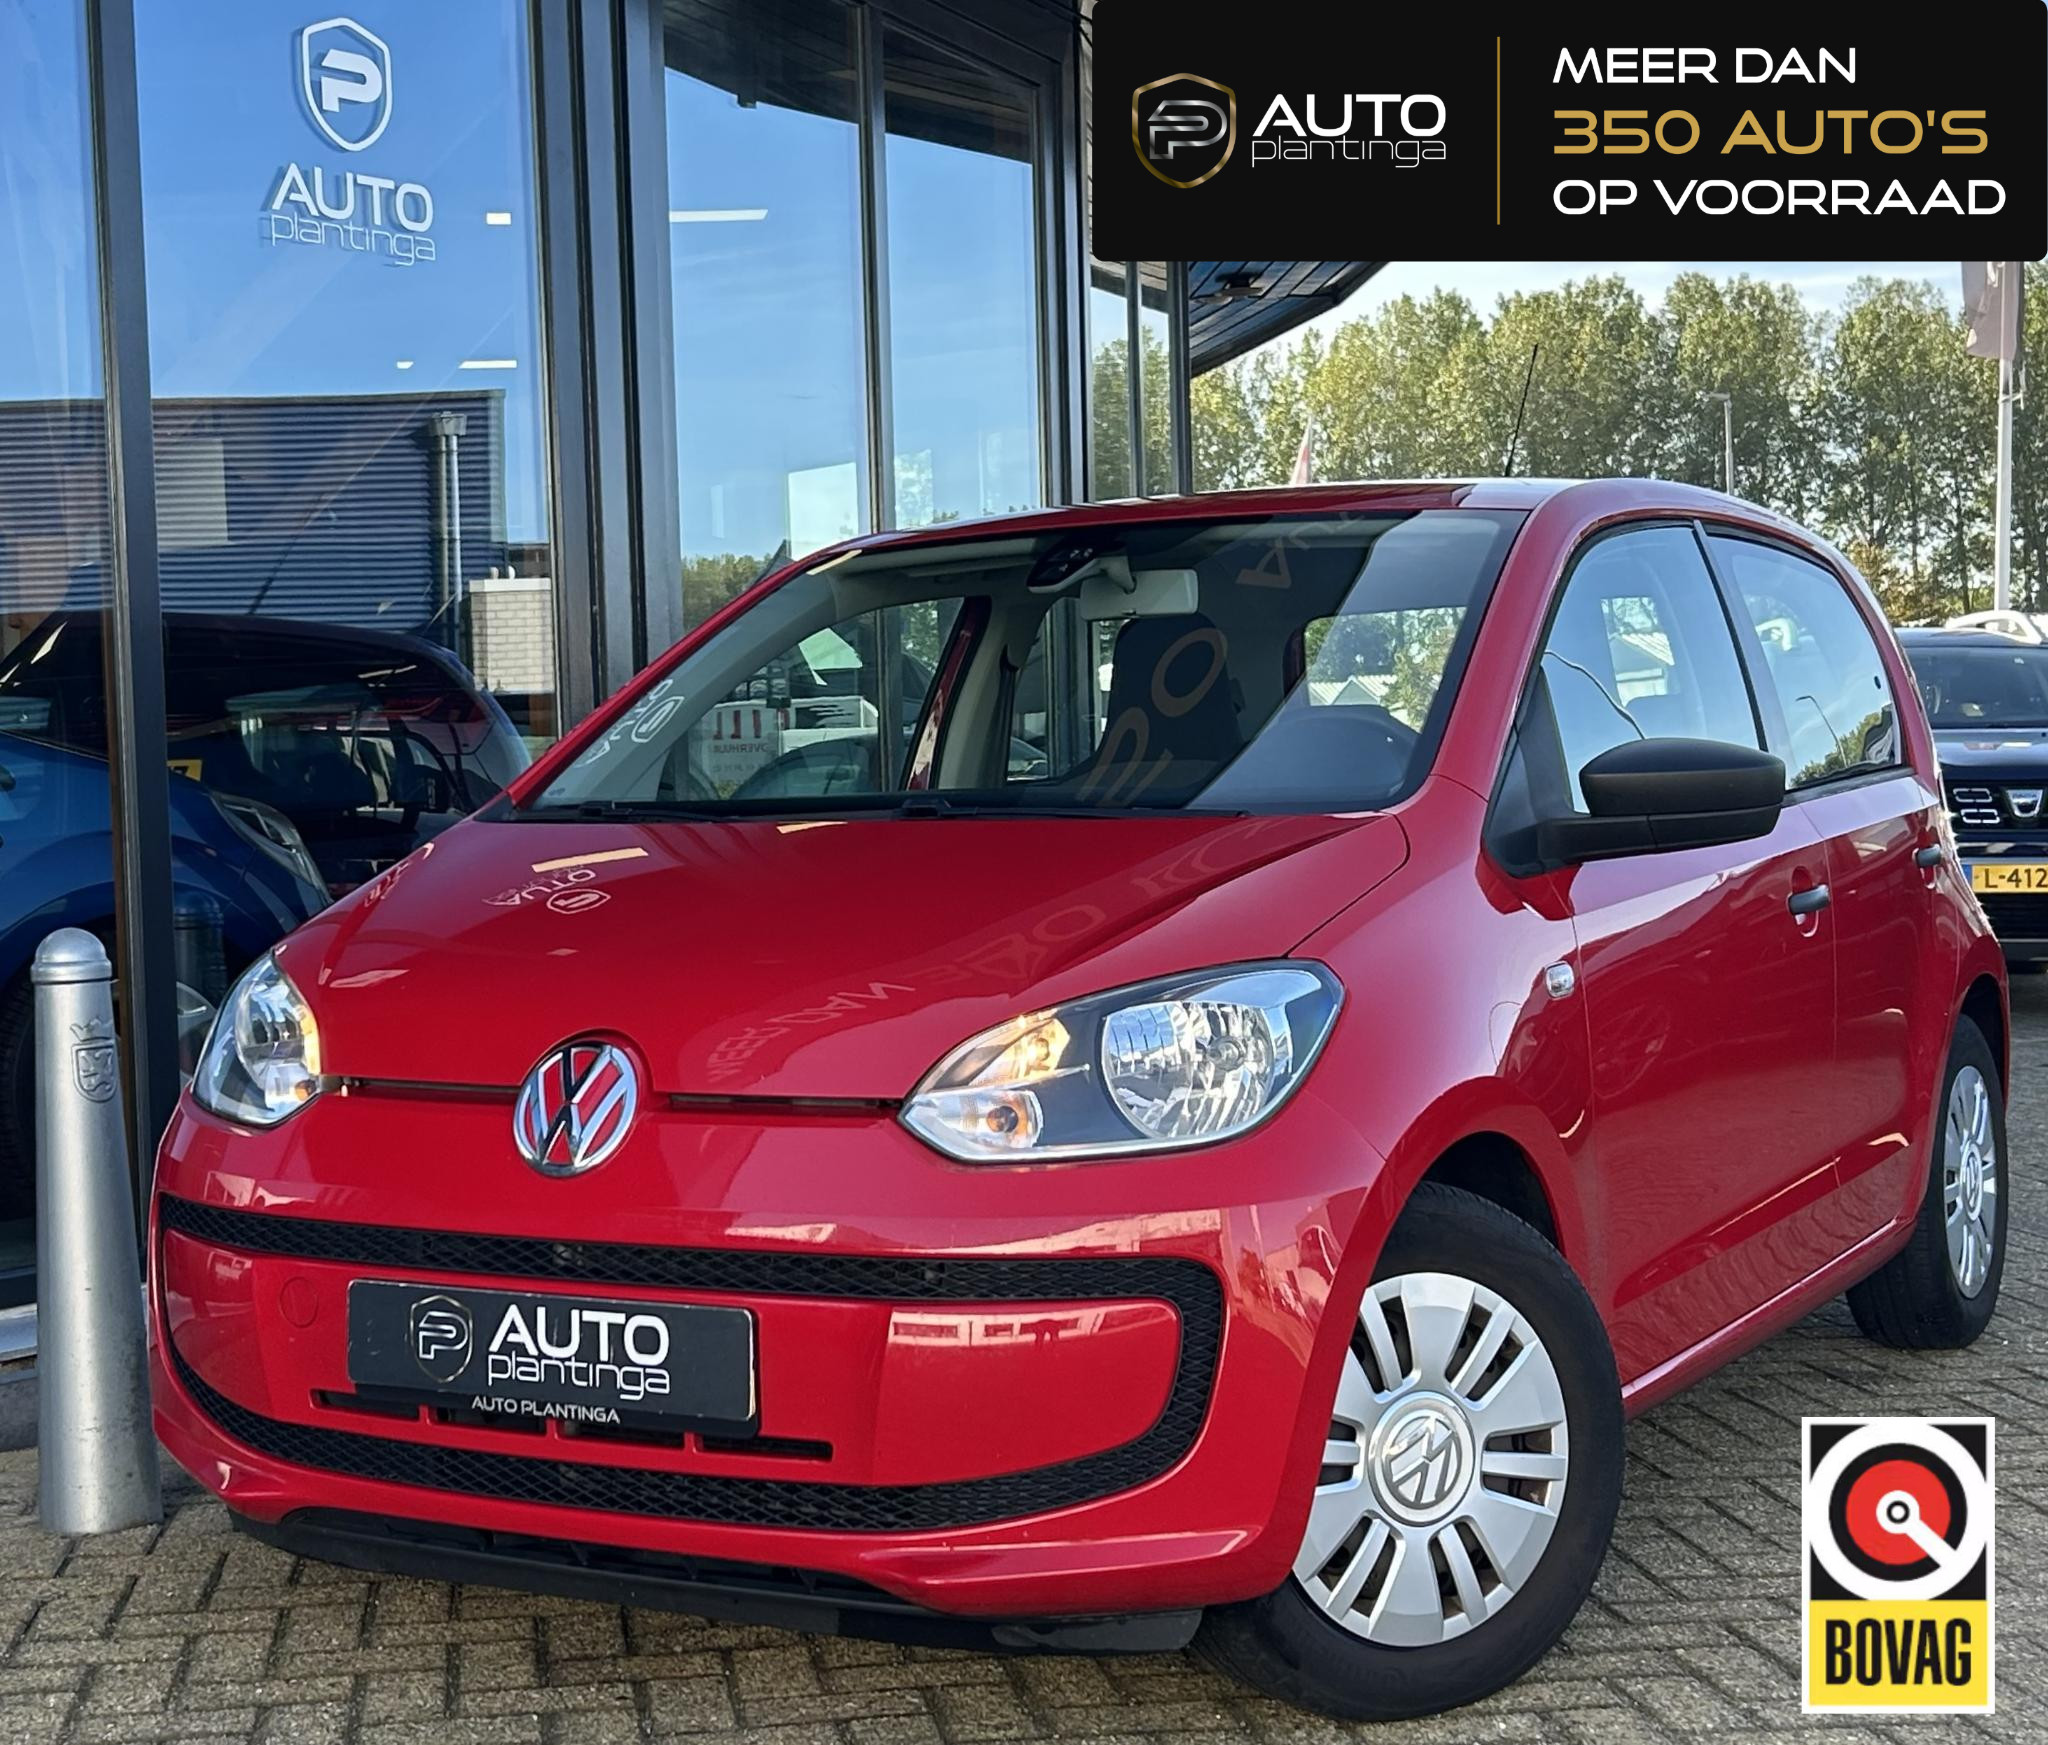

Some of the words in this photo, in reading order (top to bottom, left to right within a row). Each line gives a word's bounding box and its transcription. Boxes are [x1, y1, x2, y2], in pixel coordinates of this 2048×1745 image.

[271, 162, 434, 232] AUTO
[270, 212, 436, 267] plantinga
[488, 1303, 670, 1366] AUTO
[488, 1350, 671, 1401] plantinga
[471, 1395, 518, 1414] AUTO
[520, 1400, 621, 1424] PLANTINGA
